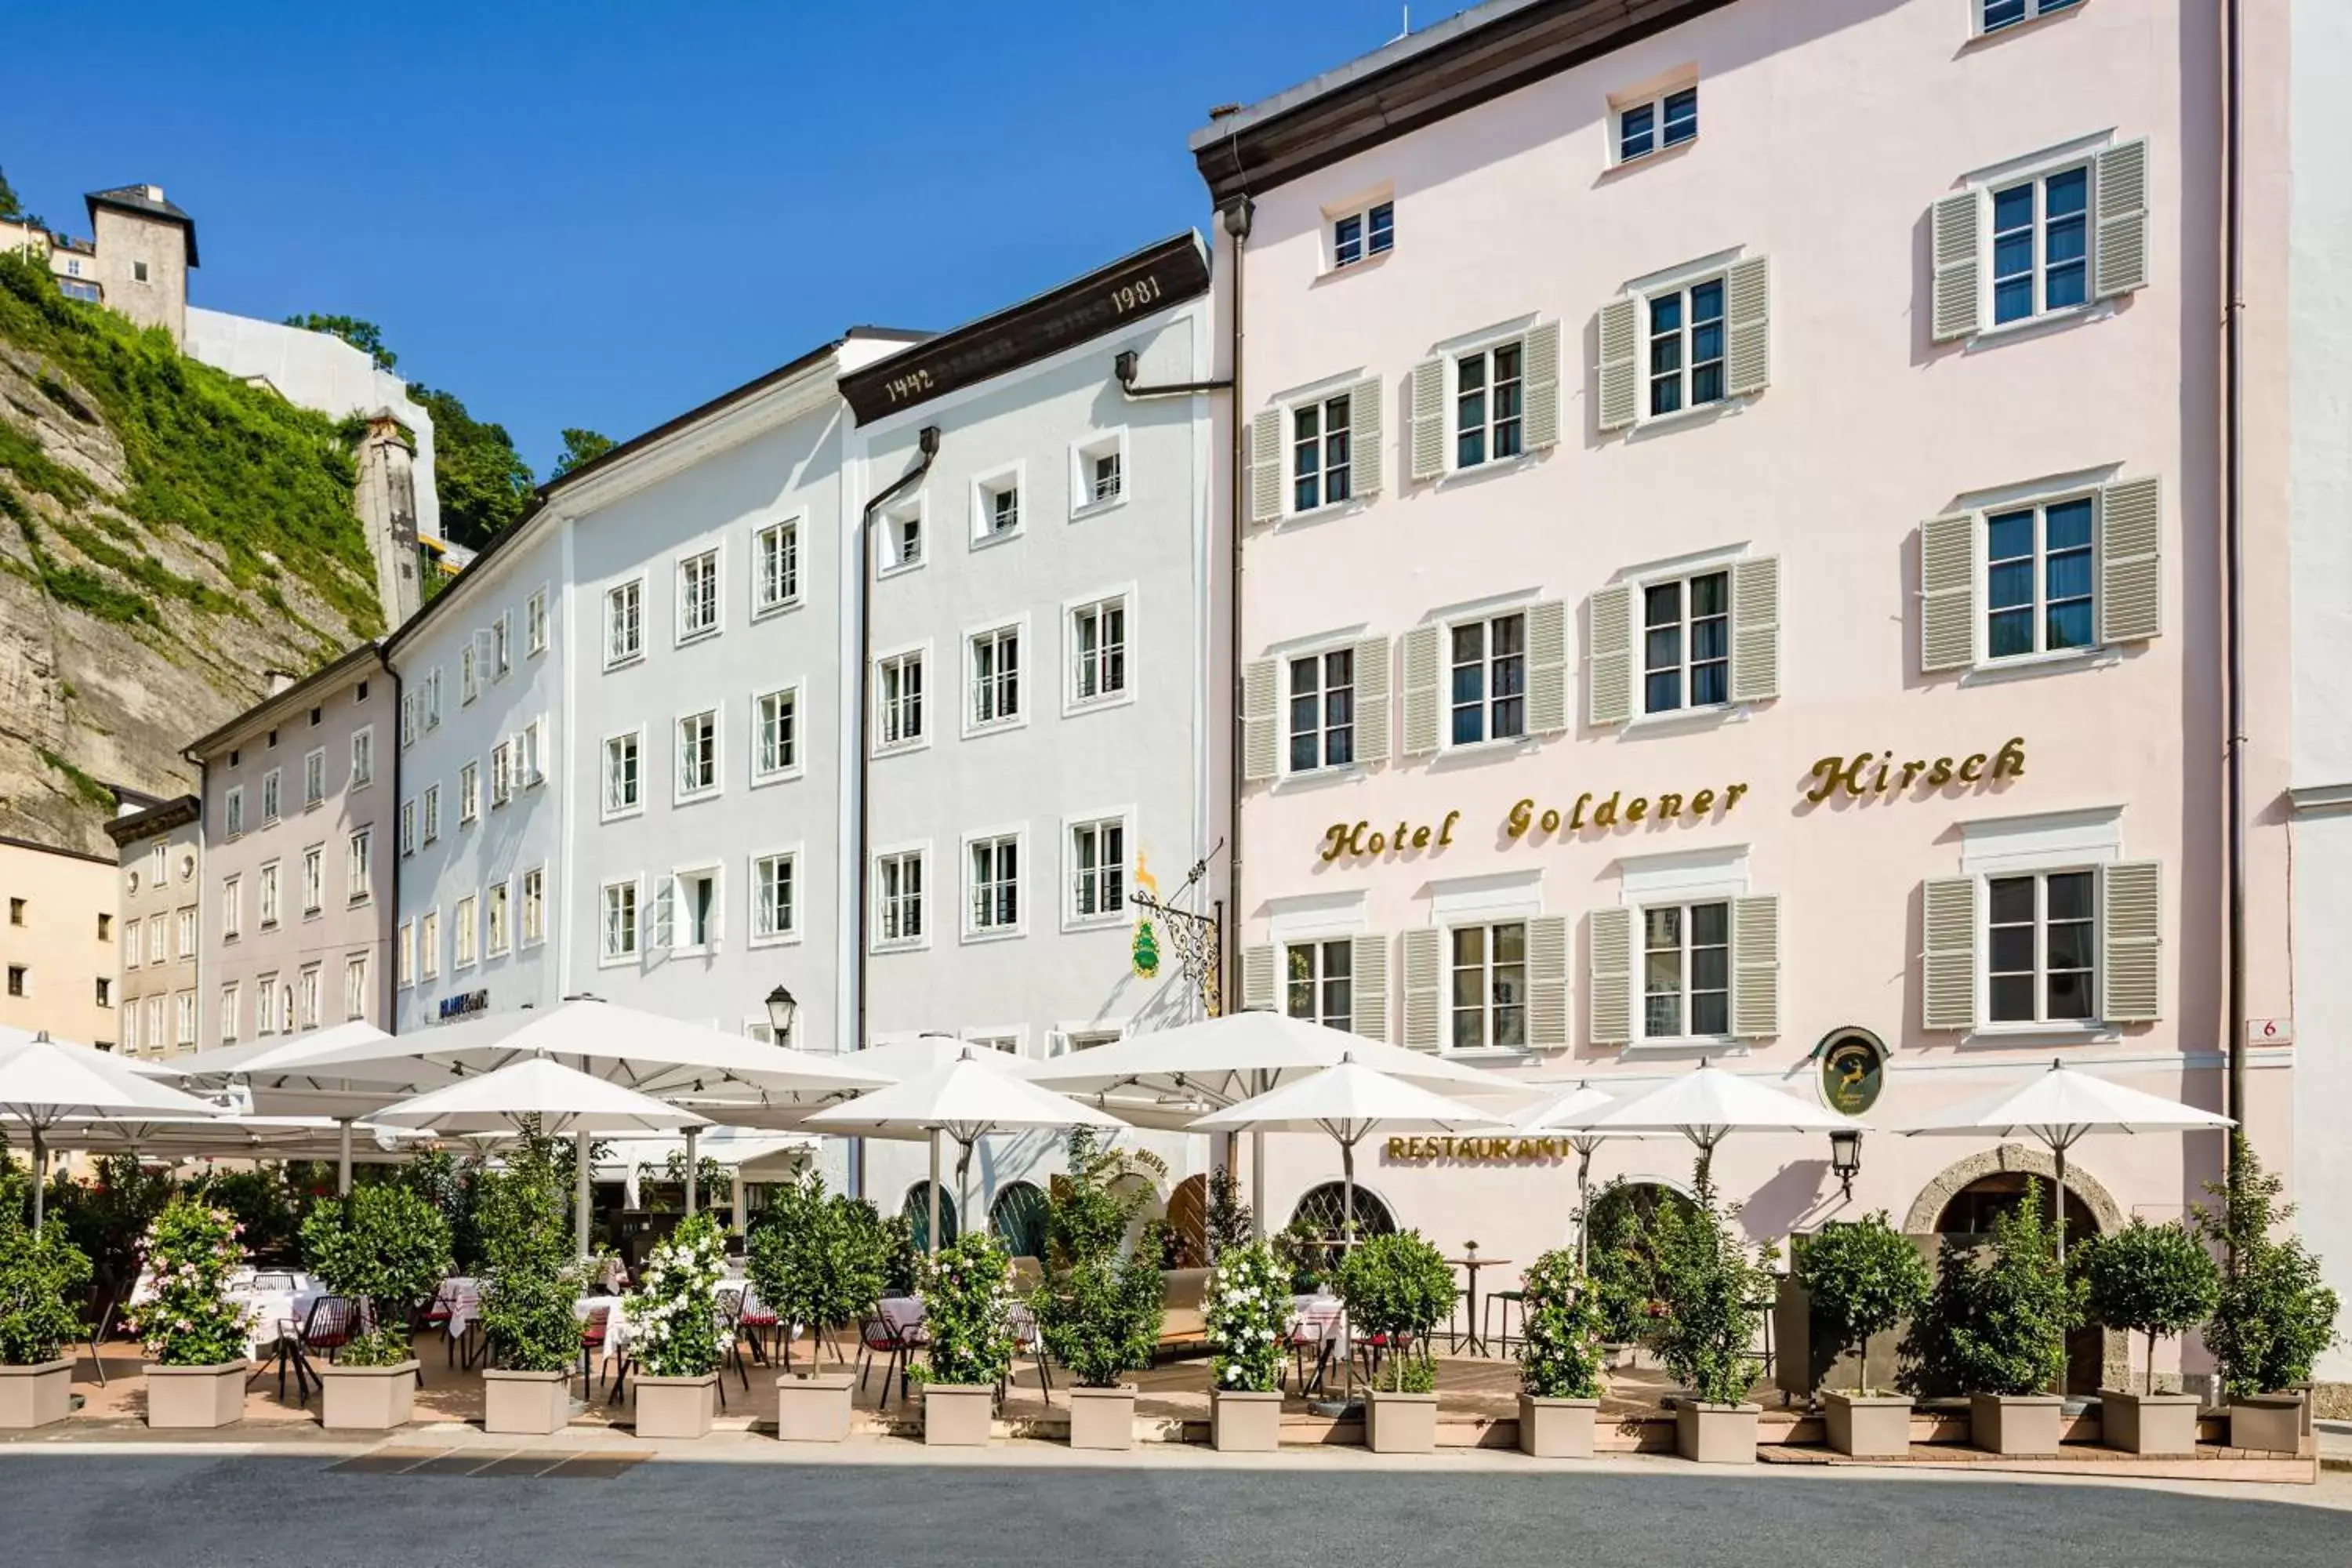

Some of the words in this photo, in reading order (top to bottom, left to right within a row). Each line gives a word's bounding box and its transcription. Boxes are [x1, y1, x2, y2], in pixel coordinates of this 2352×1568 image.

[884, 369, 935, 402] 1442
[1111, 275, 1161, 314] 1981
[1321, 810, 1461, 862] Hotel
[1507, 782, 1748, 839] Goldener
[1806, 736, 2025, 803] Hirsch
[2264, 1021, 2276, 1036] 6
[1387, 1135, 1569, 1160] RESTAURANT
